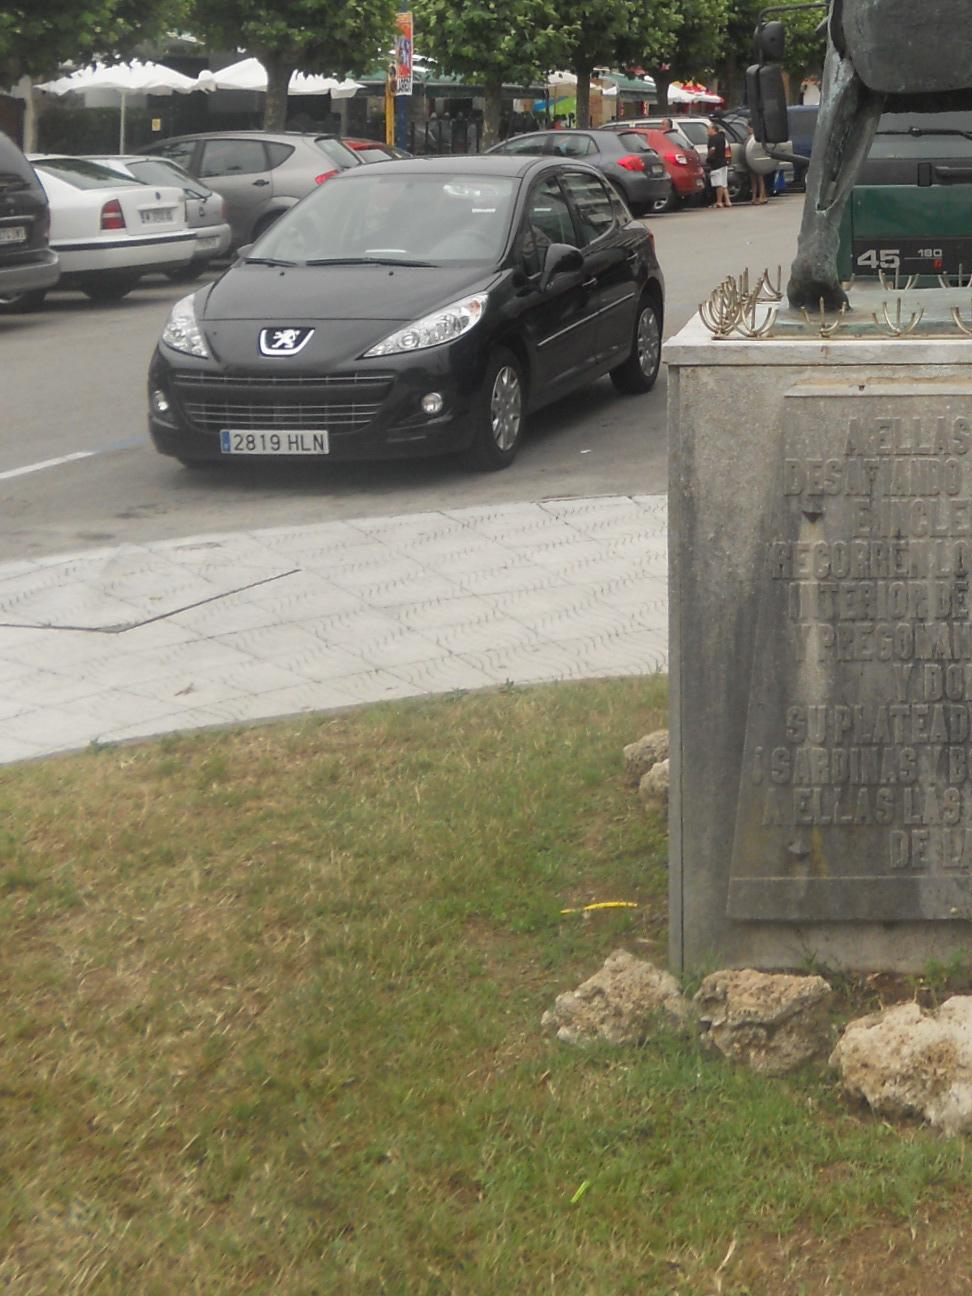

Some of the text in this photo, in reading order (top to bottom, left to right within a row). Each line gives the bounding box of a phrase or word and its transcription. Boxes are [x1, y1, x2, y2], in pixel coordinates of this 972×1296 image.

[857, 249, 900, 268] 45
[233, 433, 325, 452] 2819 HLN
[873, 416, 971, 456] ELLAS
[772, 540, 928, 580] RECORREN
[934, 580, 970, 620] DE
[785, 704, 828, 745] SU
[792, 787, 895, 826] ELLAS
[903, 787, 962, 825] LAS
[889, 829, 931, 870] DE
